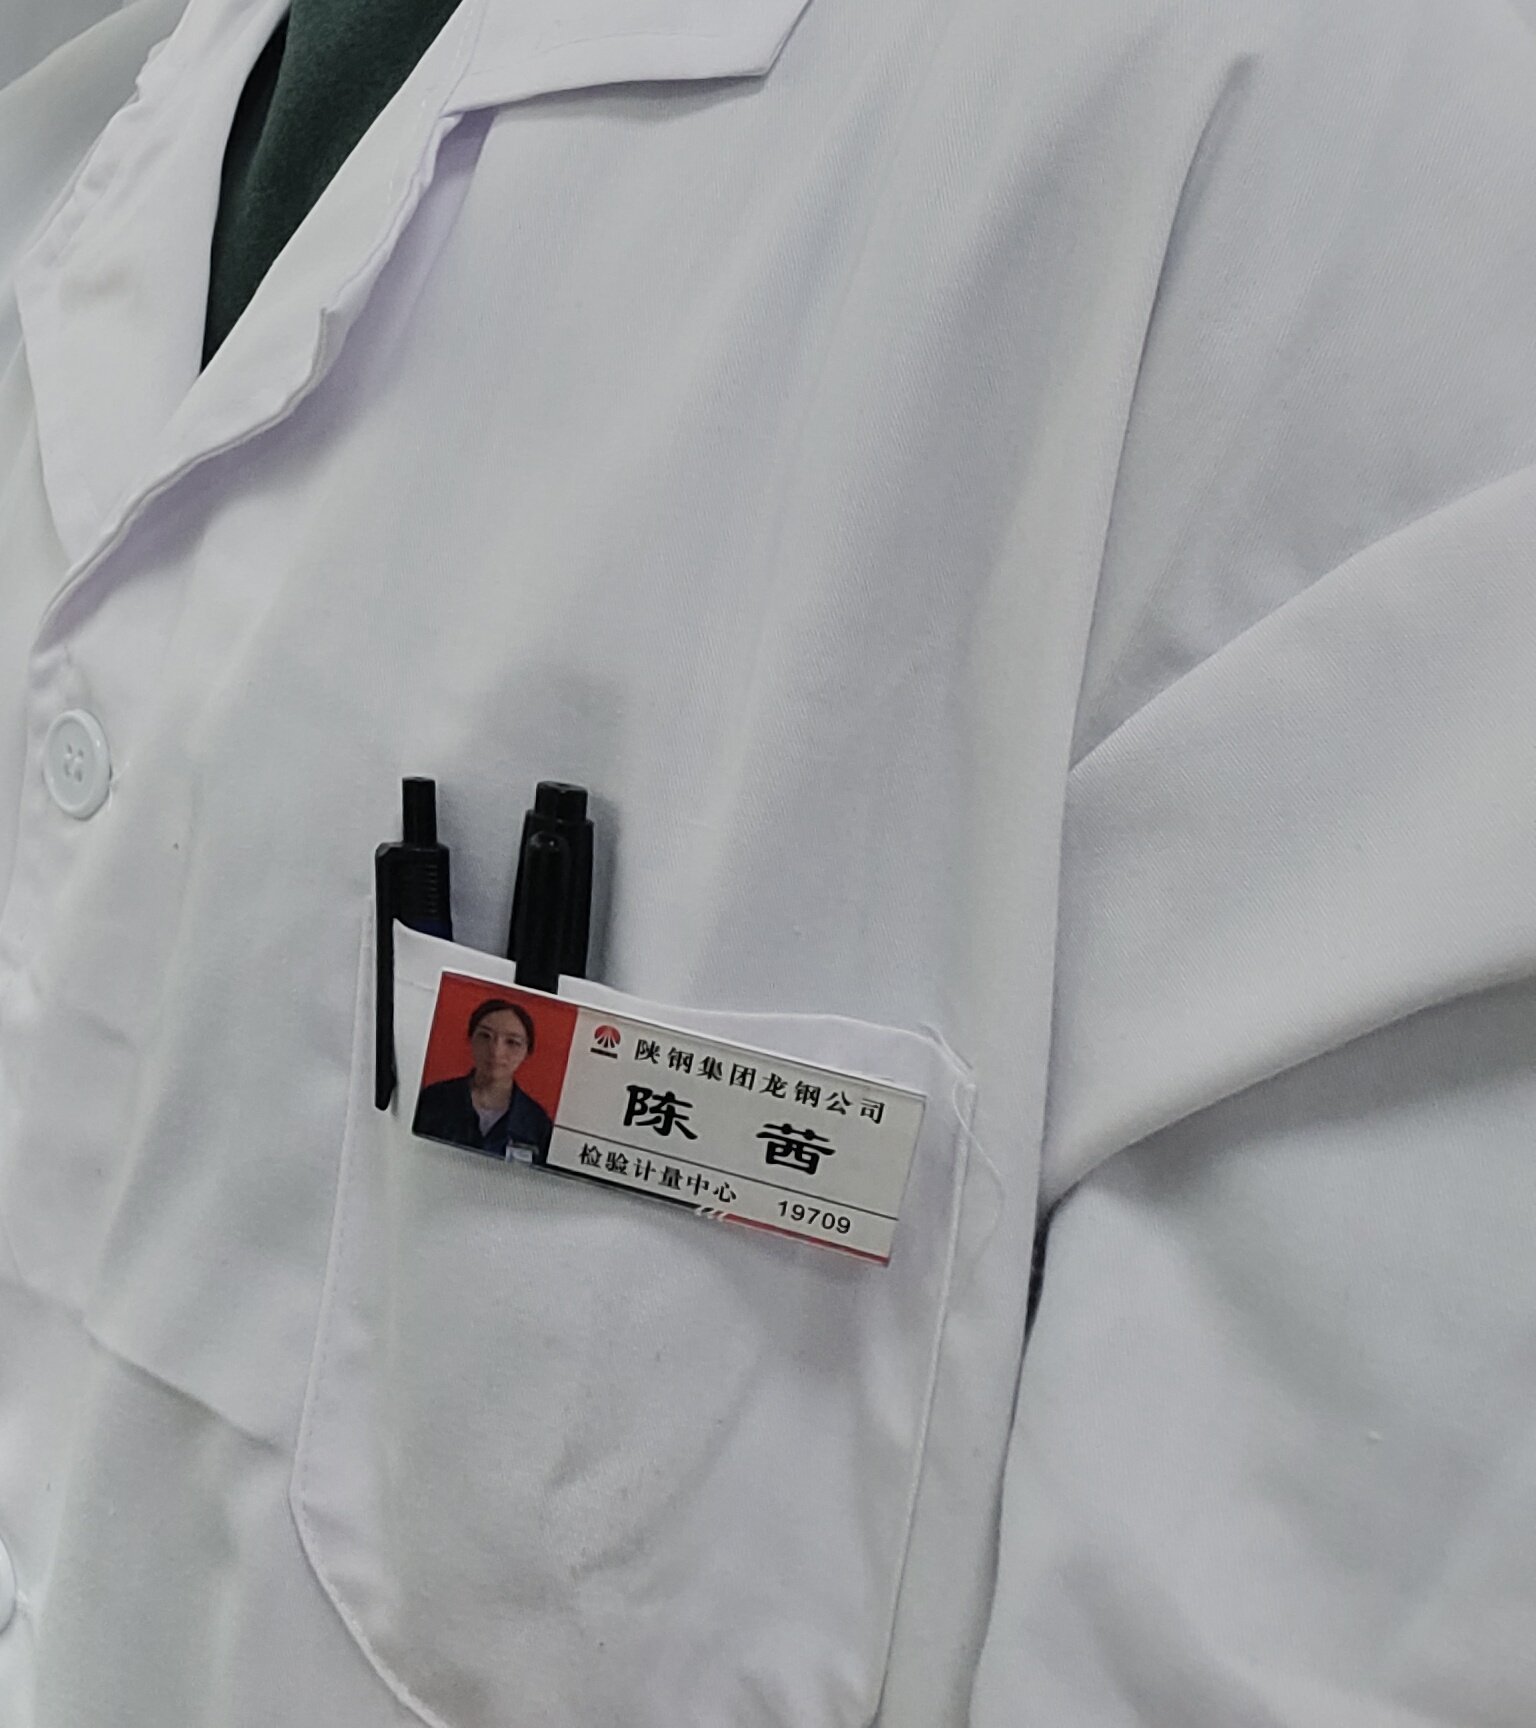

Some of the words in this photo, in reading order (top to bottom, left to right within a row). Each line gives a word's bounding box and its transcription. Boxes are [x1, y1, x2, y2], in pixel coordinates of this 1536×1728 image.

[634, 1038, 886, 1124] 陕钢集团龙钢公司
[578, 1143, 738, 1203] 检验计量中心
[778, 1199, 852, 1235] 19709
